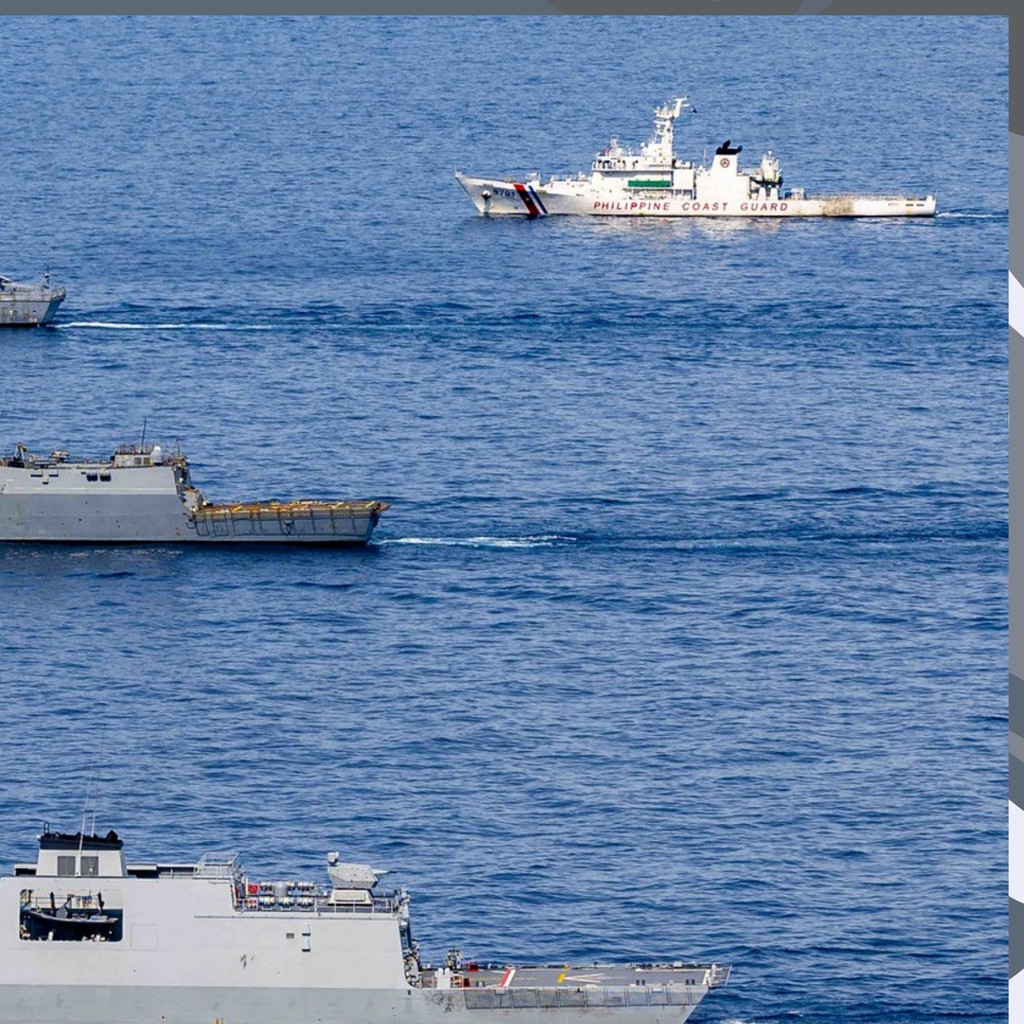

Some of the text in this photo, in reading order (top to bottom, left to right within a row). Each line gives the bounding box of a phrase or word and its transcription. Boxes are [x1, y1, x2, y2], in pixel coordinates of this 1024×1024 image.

[593, 201, 788, 211] PHILIPPINE COAST GUARD
